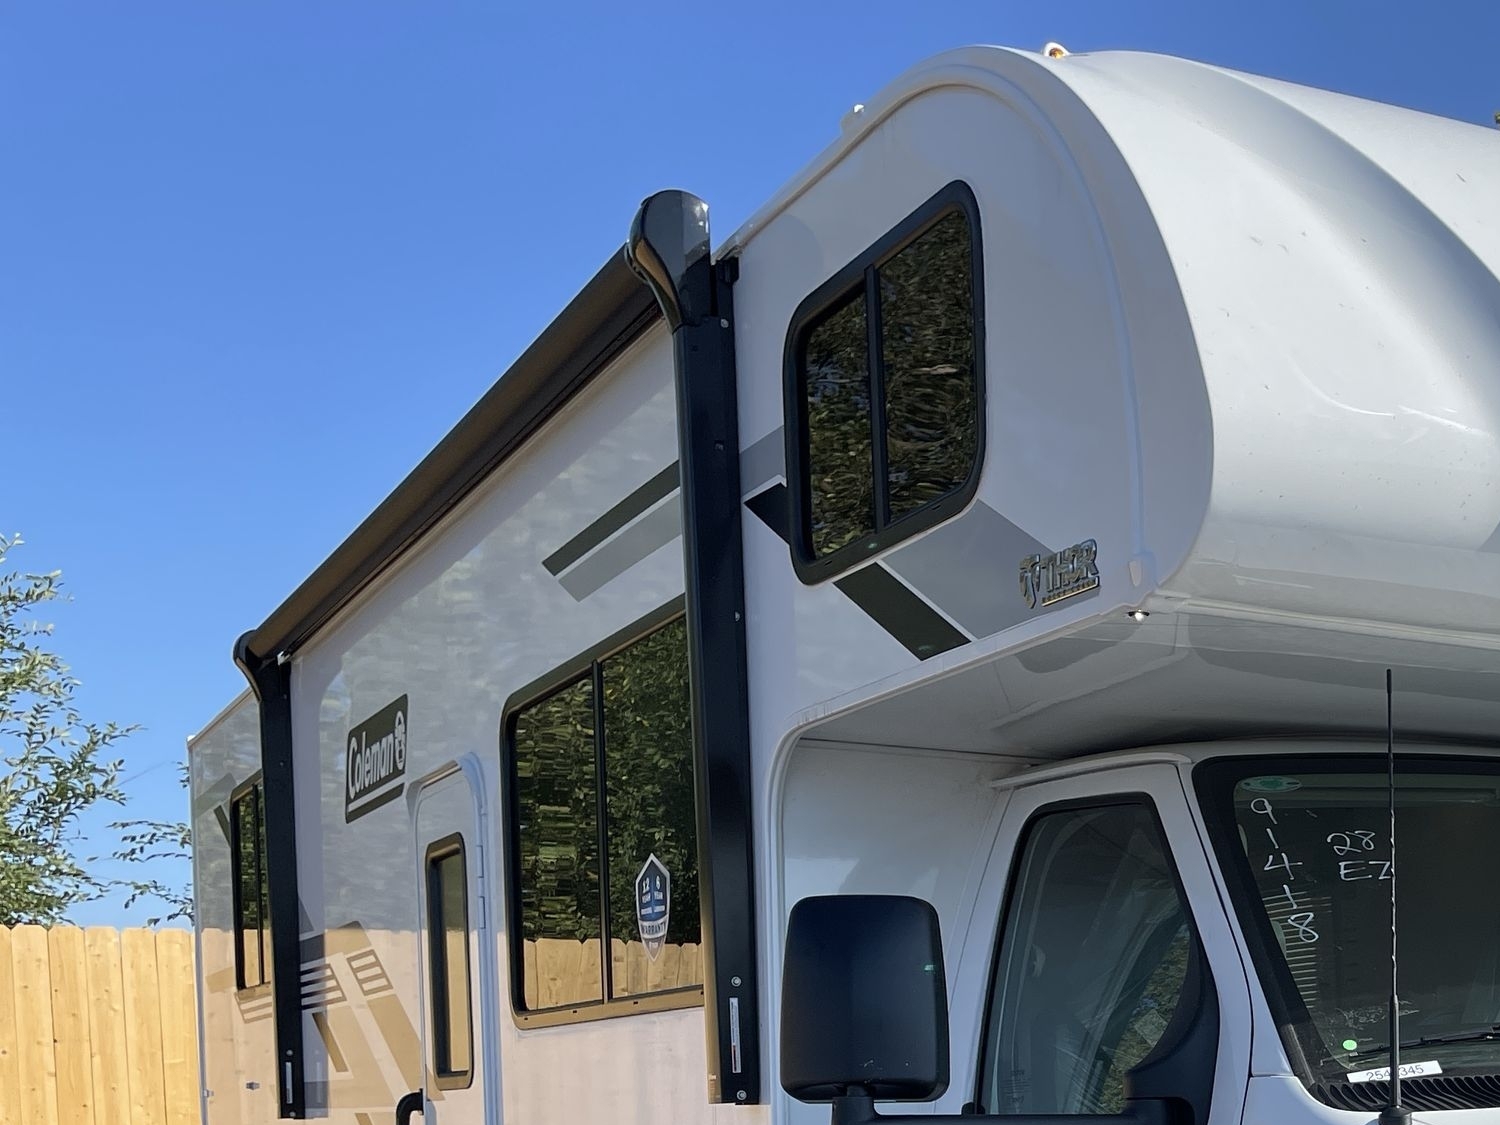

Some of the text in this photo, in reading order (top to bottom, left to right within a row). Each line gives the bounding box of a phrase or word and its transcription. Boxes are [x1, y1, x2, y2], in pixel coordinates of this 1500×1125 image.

[1041, 539, 1099, 593] THOR
[348, 731, 394, 799] Coleman
[1326, 830, 1376, 855] 28
[1366, 1064, 1425, 1081] 254345
